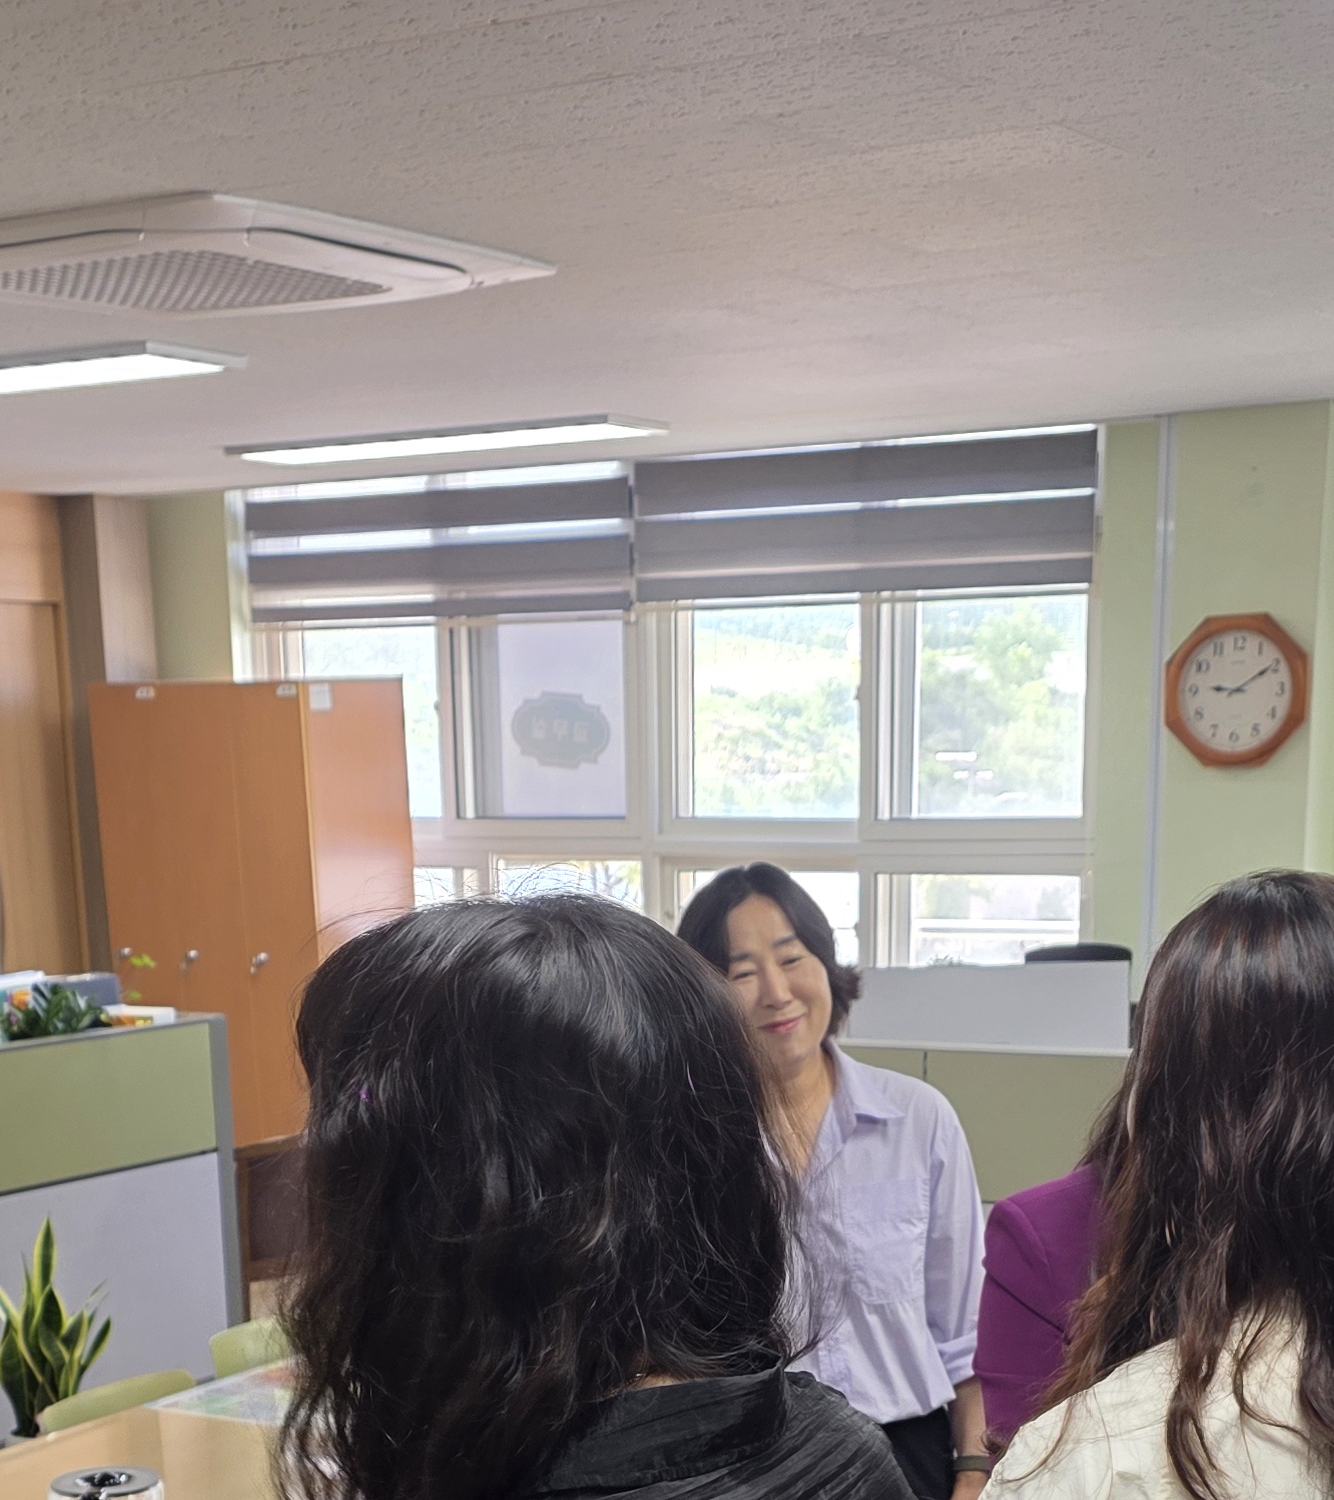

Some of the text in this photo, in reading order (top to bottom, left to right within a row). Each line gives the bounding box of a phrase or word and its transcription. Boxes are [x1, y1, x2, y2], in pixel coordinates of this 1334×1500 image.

[1213, 641, 1225, 656] 11
[1233, 635, 1247, 651] 12
[1257, 640, 1264, 655] 1
[1196, 659, 1210, 673] 10
[1270, 658, 1280, 674] 2
[1188, 683, 1199, 697] 9
[1275, 681, 1285, 697] 3
[1194, 706, 1204, 721] 8
[1266, 705, 1277, 719] 4
[1210, 723, 1219, 737] 7
[1229, 729, 1240, 742] 6
[1250, 723, 1261, 737] 5
